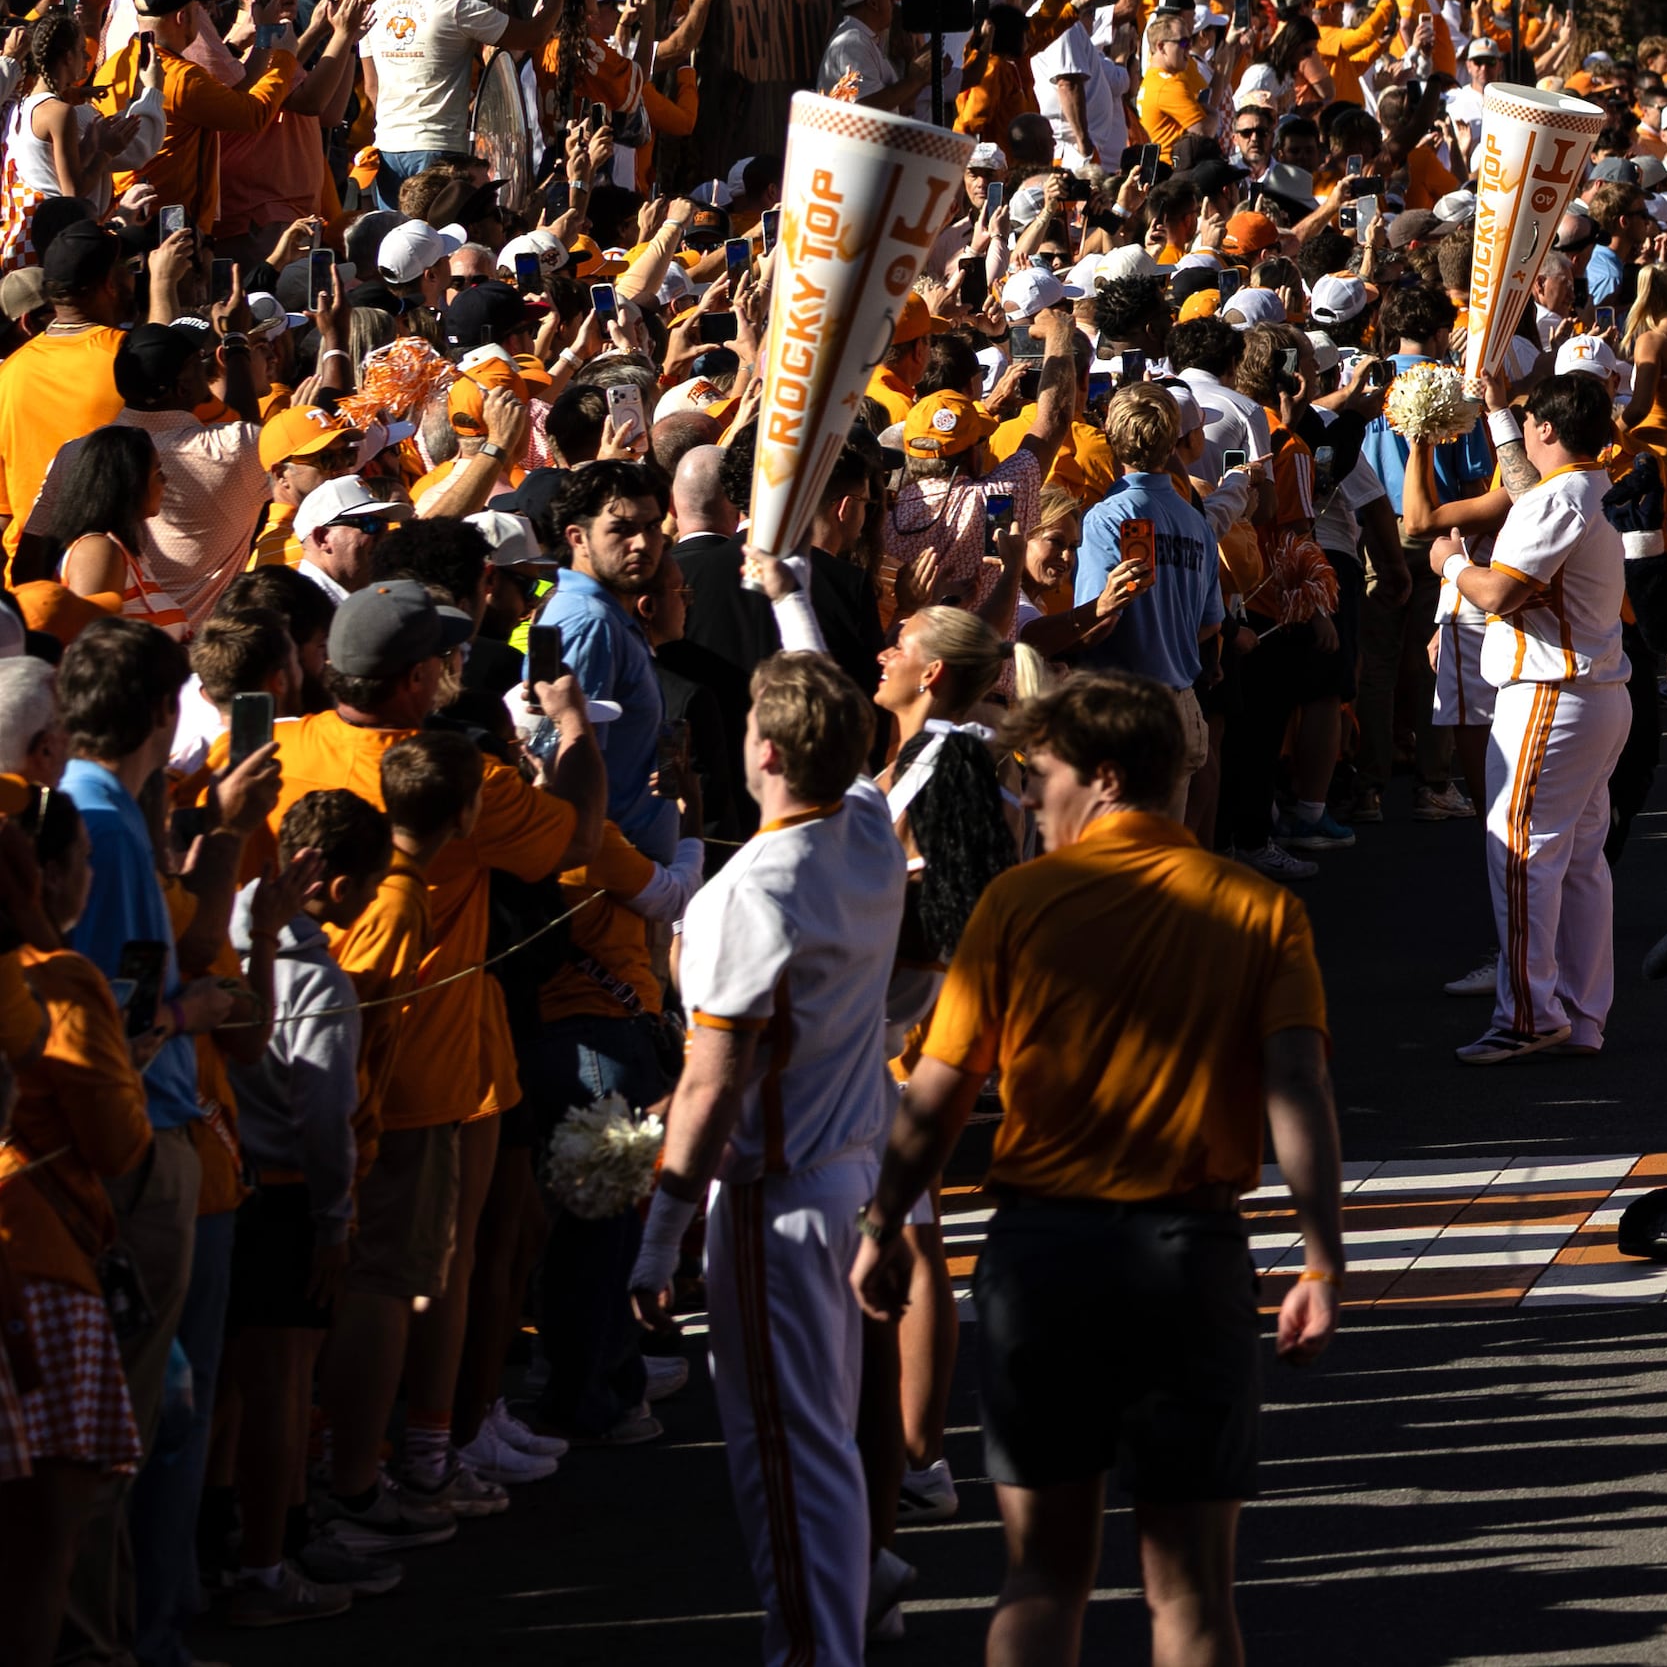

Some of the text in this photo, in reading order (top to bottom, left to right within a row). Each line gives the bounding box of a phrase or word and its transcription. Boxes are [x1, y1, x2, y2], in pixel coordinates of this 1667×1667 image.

[1532, 137, 1577, 184] T
[889, 175, 952, 249] T
[1471, 133, 1502, 312] ROCKY TOP
[767, 167, 844, 448] ROCKY TOP
[1573, 345, 1590, 359] T
[305, 408, 332, 429] T
